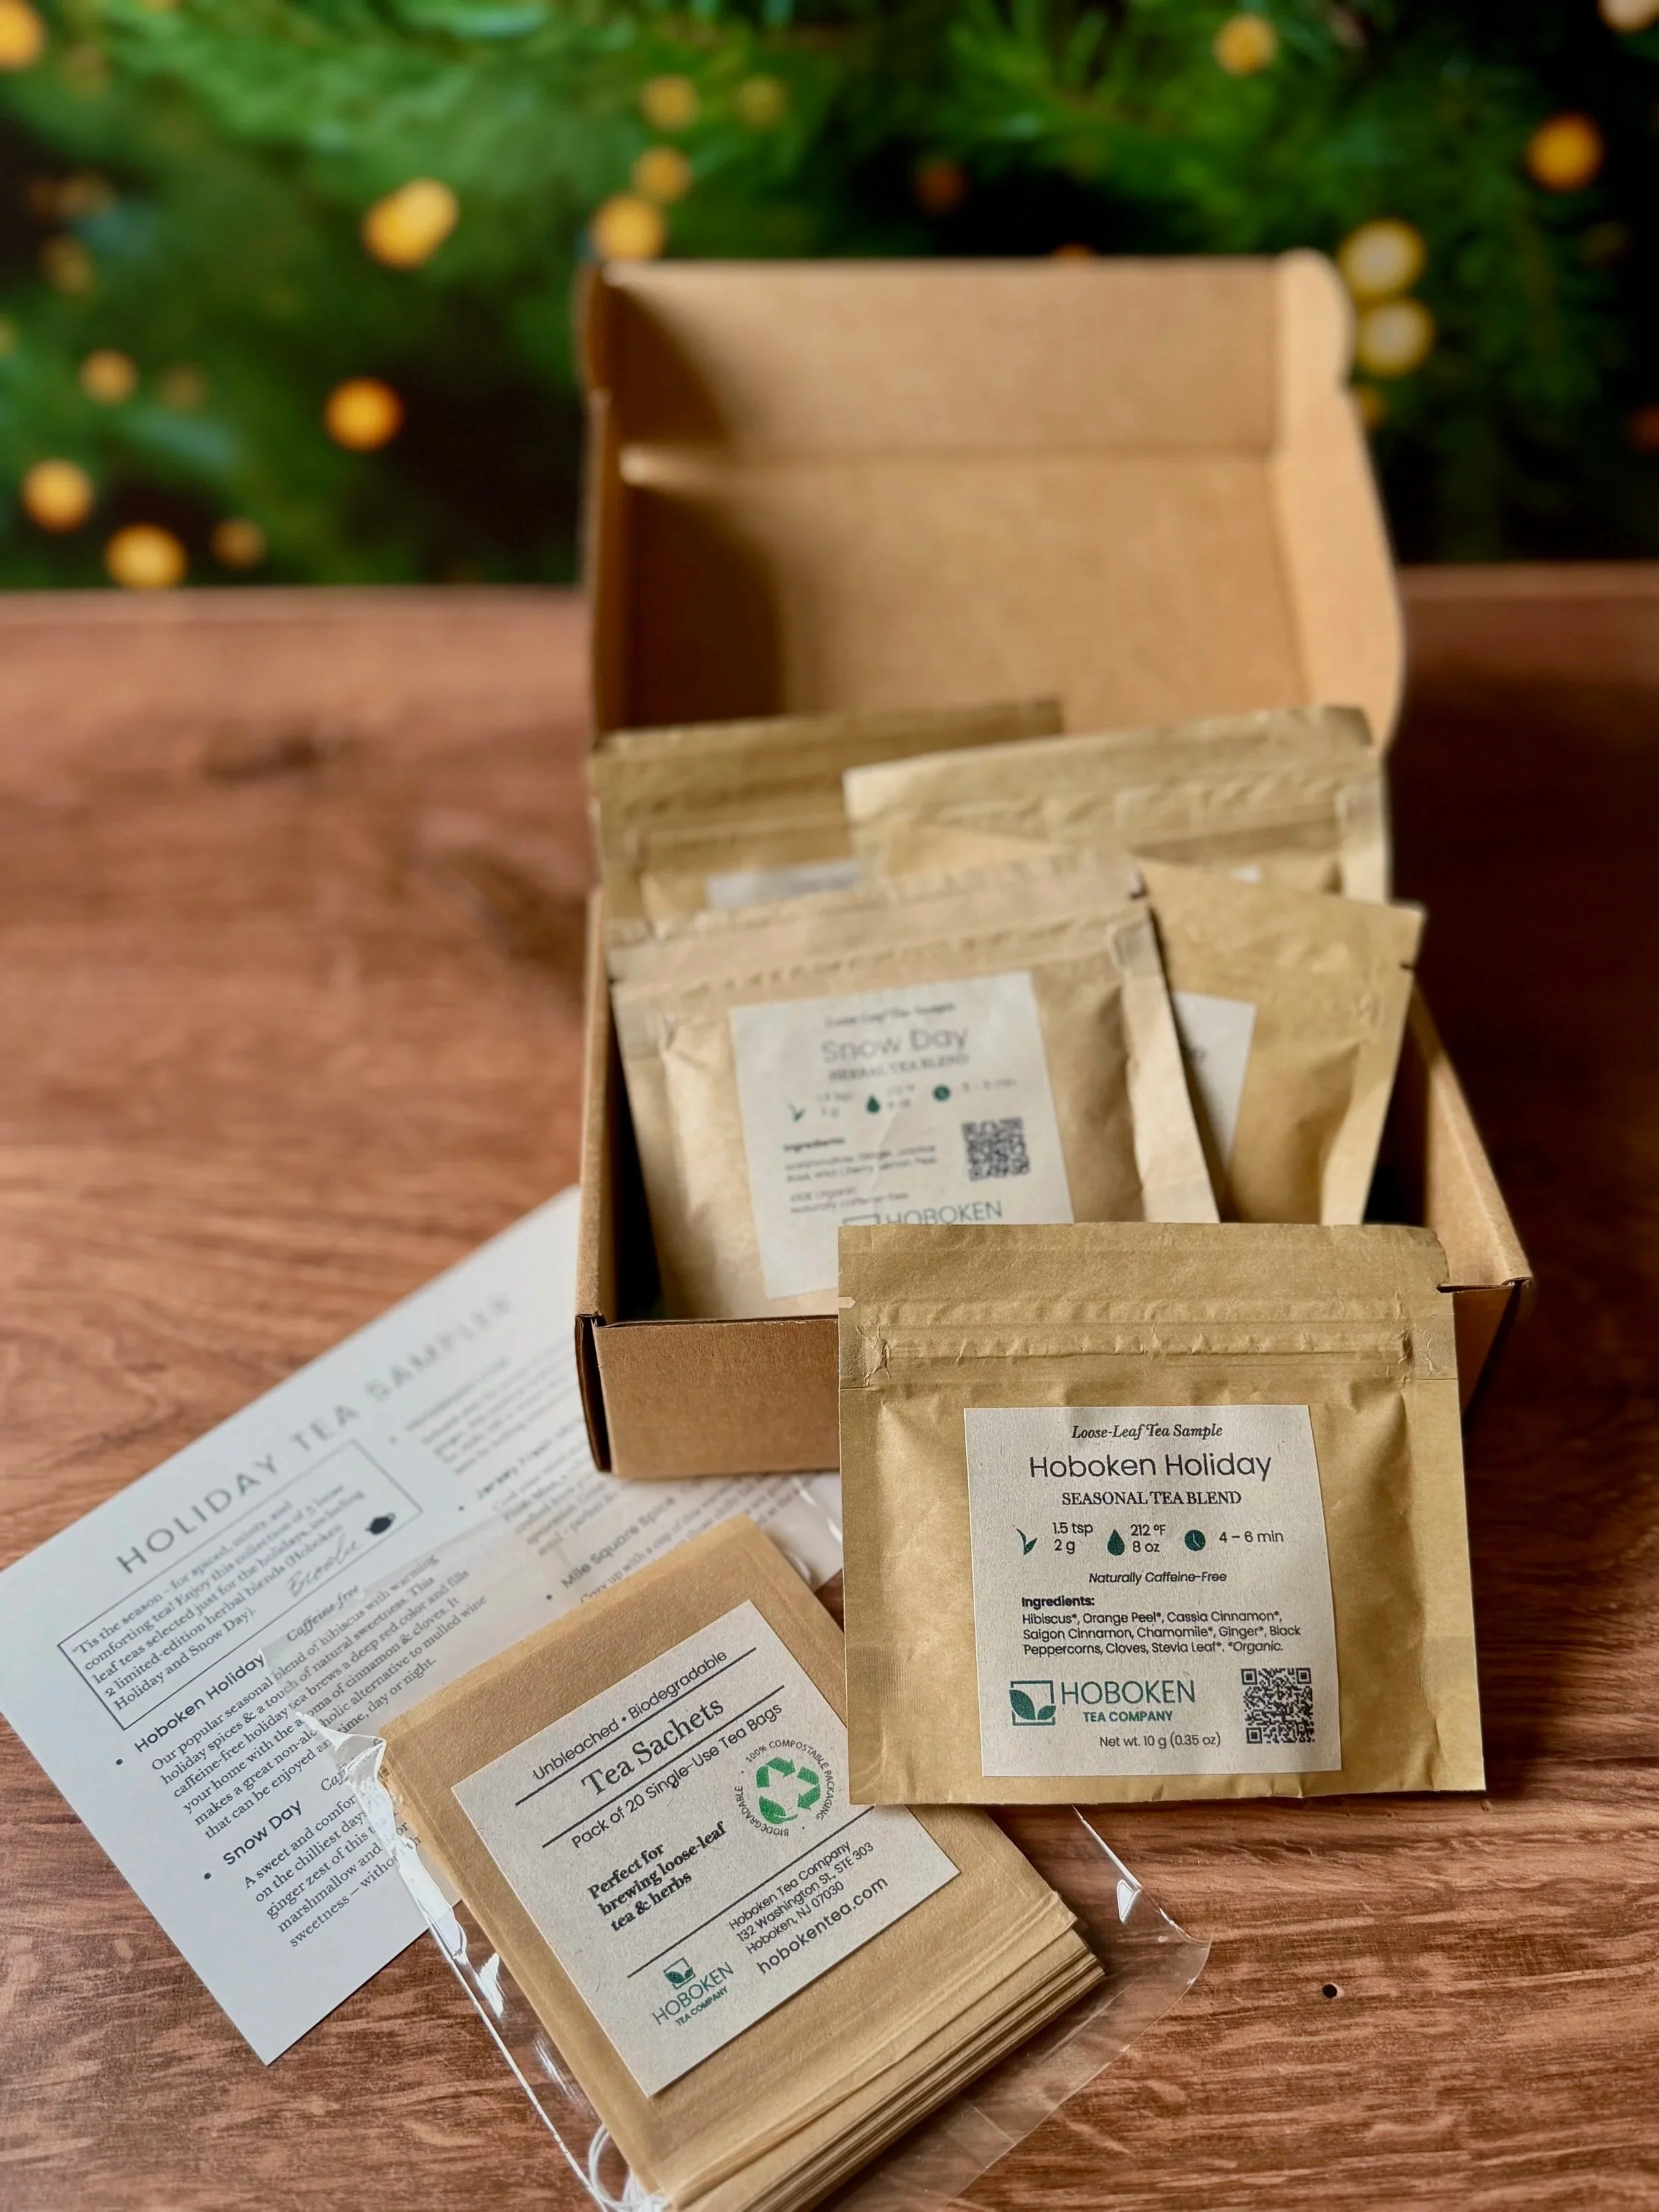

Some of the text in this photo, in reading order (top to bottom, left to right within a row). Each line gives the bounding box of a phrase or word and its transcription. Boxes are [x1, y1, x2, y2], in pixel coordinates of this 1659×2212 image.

[820, 1028, 969, 1063] Snow Day
[1071, 1423, 1223, 1441] Loose-Leaf Tea Sample
[115, 1454, 277, 1574] HOLIDAY
[291, 1405, 358, 1452] TEA
[1029, 1452, 1271, 1482] Hoboken Holiday
[1062, 1491, 1242, 1506] SEASONAL TEA BLEND
[561, 1563, 591, 1589] Mile
[590, 1526, 640, 1564] Square
[1052, 1522, 1094, 1536] 1.5 tsp
[1054, 1538, 1076, 1554] 2 g
[1130, 1524, 1151, 1536] 212
[1132, 1540, 1160, 1553] 8 oz
[1218, 1530, 1284, 1544] 4 6 min
[1021, 1595, 1095, 1609] Ingredients:
[1088, 1571, 1228, 1585] Naturally Caffeine-Free
[84, 1620, 155, 1670] comforting
[151, 1601, 176, 1623] tea!
[92, 1593, 219, 1684] leaf teas selected just
[98, 1593, 163, 1640] the season
[105, 1687, 117, 1698] 2
[113, 1623, 206, 1690] limited-edition
[204, 1591, 246, 1625] herbal
[1023, 1629, 1066, 1643] Saigon
[1068, 1627, 1134, 1640] Cinnamon,
[1269, 1625, 1301, 1637] Black
[1082, 1613, 1129, 1626] Orange
[1167, 1611, 1208, 1623] Cassia
[113, 1672, 165, 1711] Holiday
[165, 1652, 190, 1675] and
[188, 1629, 223, 1657] Snow
[1023, 1644, 1104, 1658] Peppercorns,
[1105, 1642, 1149, 1655] Cloves,
[1151, 1641, 1189, 1653] Stevia
[134, 1655, 265, 1753] Hoboken Holiday
[151, 1609, 366, 1770] Our popular seasonal blend hibiscus
[159, 1748, 207, 1785] holiday
[207, 1722, 244, 1751] spices
[264, 1680, 299, 1708] touch
[312, 1636, 354, 1672] natural
[174, 1621, 399, 1798] caffeine-free holiday brews deep red
[532, 1652, 727, 1780] Unbleached Biodegradable
[1060, 1679, 1195, 1705] HOBOKEN
[1082, 1710, 1173, 1723] TEA COMPANY
[183, 1643, 401, 1814] your home with the cinnamon
[194, 1657, 410, 1826] makes great alternative
[204, 1816, 232, 1839] that
[271, 1748, 317, 1788] enjoyed
[368, 1693, 389, 1713] day
[402, 1659, 437, 1685] night.
[581, 1700, 724, 1795] Tea Sachets
[1100, 1732, 1221, 1749] Net wt. 10 g (0.35 oz)
[571, 1704, 782, 1849] Pack of 20 Single-Use Tea Bags
[745, 1739, 835, 1820] 100% COMPOSTABLE PACKAGING
[222, 1800, 302, 1866] Snow Day
[735, 1785, 789, 1836] BIODEGRADABLE
[256, 1848, 291, 1879] sweet
[266, 1832, 369, 1920] ginger zest this
[272, 1830, 342, 1888] the chilliest
[277, 1842, 383, 1933] marshmallow and
[587, 1844, 664, 1900] Perfect for
[597, 1820, 727, 1916] brewing loose-leaf
[729, 1841, 851, 1931] Hoboken Tea Company
[289, 1895, 350, 1947] sweetness
[611, 1872, 692, 1931] tea & herbs
[736, 1925, 757, 1942] 132
[754, 1881, 820, 1929] Washington
[833, 1856, 854, 1874] STE
[852, 1842, 874, 1860] 303
[746, 1881, 844, 1954] Hoboken, NJ 07030
[757, 1878, 889, 1974] hobokentea.com
[652, 1961, 734, 2026] HOBOKEN
[675, 1986, 728, 2026] TEA COMPANY
